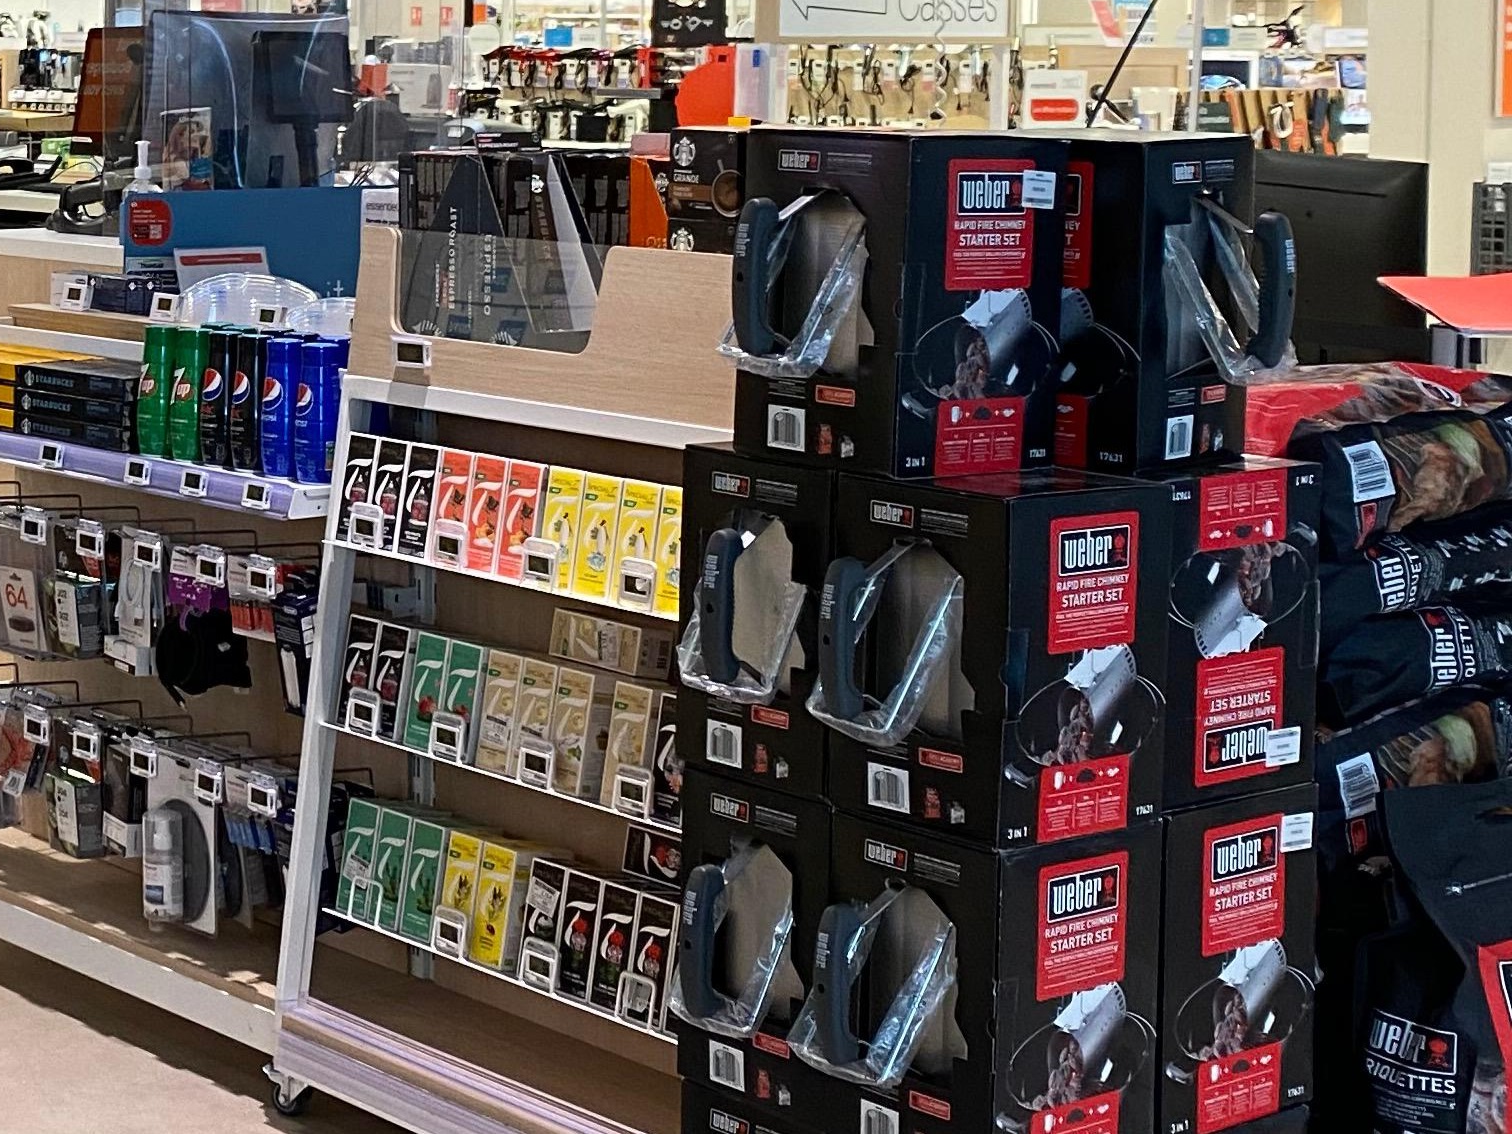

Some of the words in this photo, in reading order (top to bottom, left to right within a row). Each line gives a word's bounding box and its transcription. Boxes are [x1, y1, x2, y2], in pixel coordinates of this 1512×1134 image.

[781, 151, 810, 169] weber
[961, 174, 1011, 210] weber
[953, 220, 977, 231] RAPID
[977, 220, 994, 230] FIRE
[994, 220, 1027, 230] CHIMNEY
[736, 223, 750, 258] weber
[958, 233, 1002, 246] STARTER
[1002, 233, 1022, 245] SET
[34, 373, 75, 388] STARBUCKS
[32, 397, 72, 412] STARBUCKS
[905, 457, 912, 467] 3
[920, 456, 925, 466] 1
[1099, 451, 1123, 463] 17631
[873, 501, 903, 523] weber
[1063, 529, 1113, 569] weber
[1055, 579, 1079, 592] RAPID
[1080, 577, 1097, 589] FIRE
[1097, 573, 1130, 587] CHIMNEY
[5, 583, 29, 610] 64
[821, 584, 835, 620] weber
[1061, 590, 1105, 608] STARTER
[1105, 587, 1124, 602] SET
[1209, 698, 1229, 713] SET
[1229, 690, 1271, 708] STARTER
[1203, 711, 1237, 727] CHIMNEY
[1237, 708, 1254, 721] FIRE
[1254, 705, 1277, 718] RAPID
[1221, 726, 1268, 764] weber
[713, 796, 739, 816] weber
[1007, 828, 1013, 840] 3
[1013, 827, 1022, 838] IN
[1022, 826, 1028, 837] 1
[867, 842, 897, 865] weber
[1217, 834, 1262, 875] weber
[1052, 874, 1103, 915] weber
[1209, 884, 1231, 898] RAPID
[1231, 880, 1248, 891] FIRE
[1248, 872, 1279, 887] CHIMNEY
[683, 890, 698, 926] weber
[1214, 891, 1255, 912] STARTER
[1255, 885, 1274, 902] SET
[1044, 924, 1068, 939] RAPID
[1068, 920, 1086, 934] FIRE
[1086, 912, 1119, 929] CHIMNEY
[815, 931, 831, 969] weber
[1050, 932, 1094, 954] STARTER
[1095, 927, 1115, 943] SET
[1170, 1122, 1176, 1134] 3
[1184, 1119, 1189, 1131] 1
